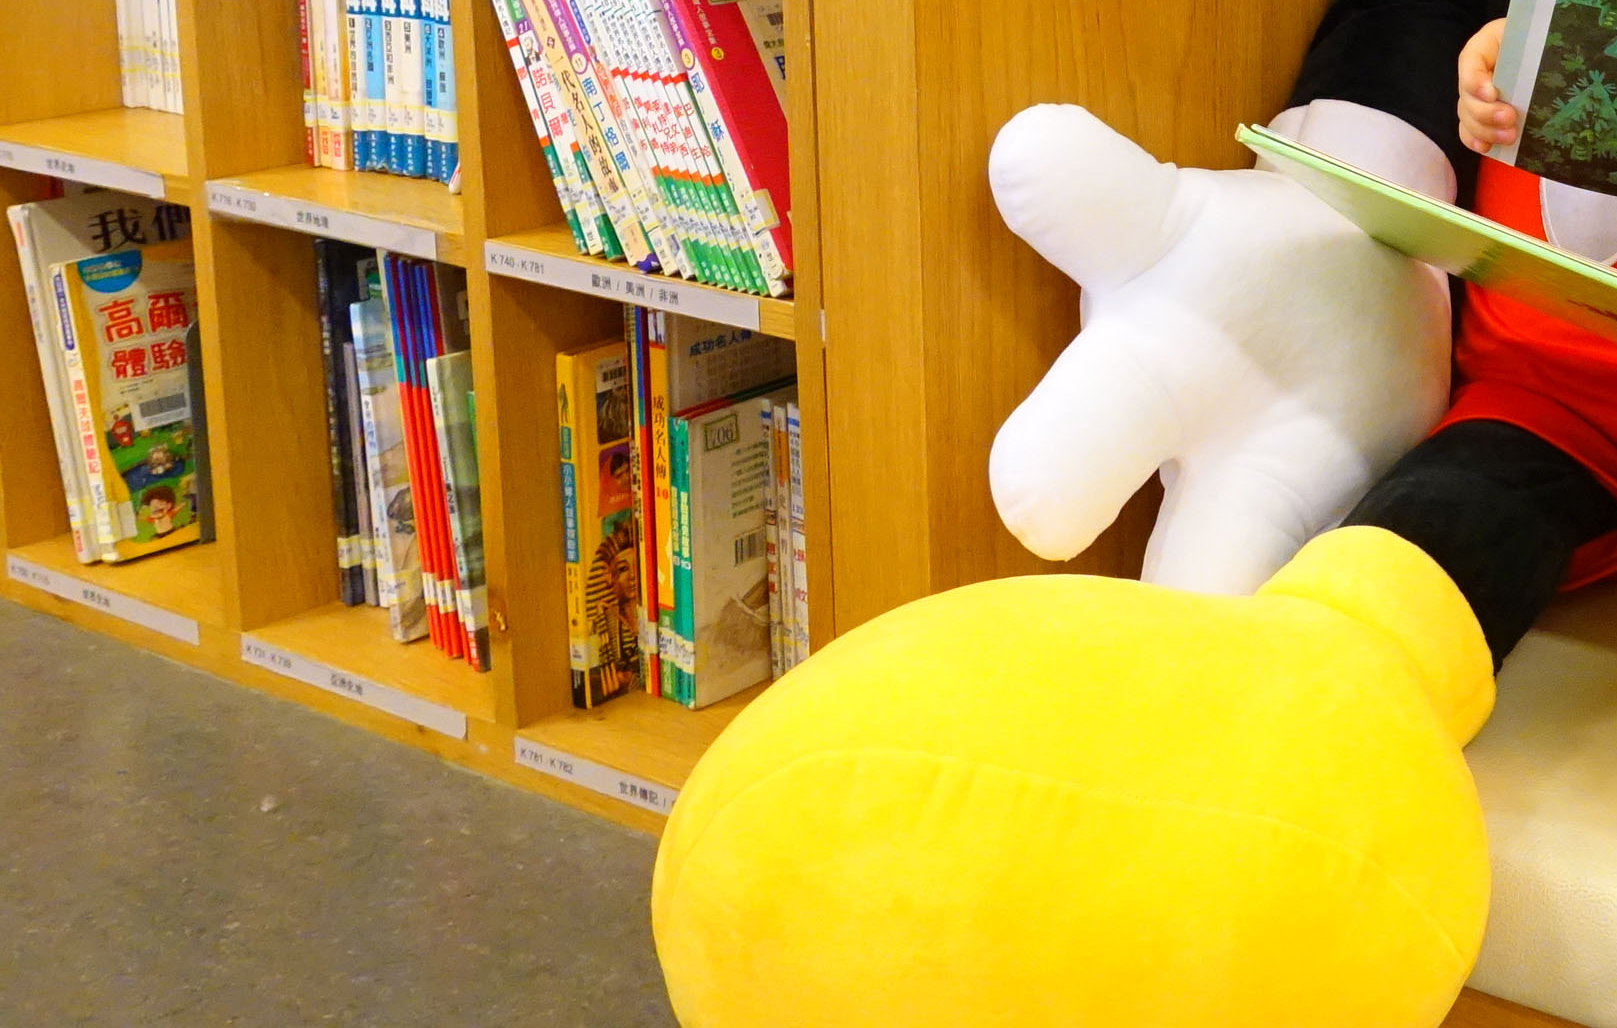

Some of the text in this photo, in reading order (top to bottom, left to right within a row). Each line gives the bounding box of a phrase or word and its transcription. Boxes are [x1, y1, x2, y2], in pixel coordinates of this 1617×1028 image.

[533, 68, 563, 137] 諾貝爾
[555, 55, 619, 193] 一代名人的故事
[582, 77, 630, 171] 南丁格爾
[651, 100, 679, 154] 萊特兄弟
[683, 102, 712, 158] 巴哈
[499, 255, 515, 268] 740
[529, 261, 544, 274] 781
[592, 274, 611, 290] 歐洲
[625, 281, 645, 297] 美洲
[659, 288, 679, 305] 非洲
[98, 290, 199, 343] 高爾
[653, 395, 669, 500] 成功名人傳 10
